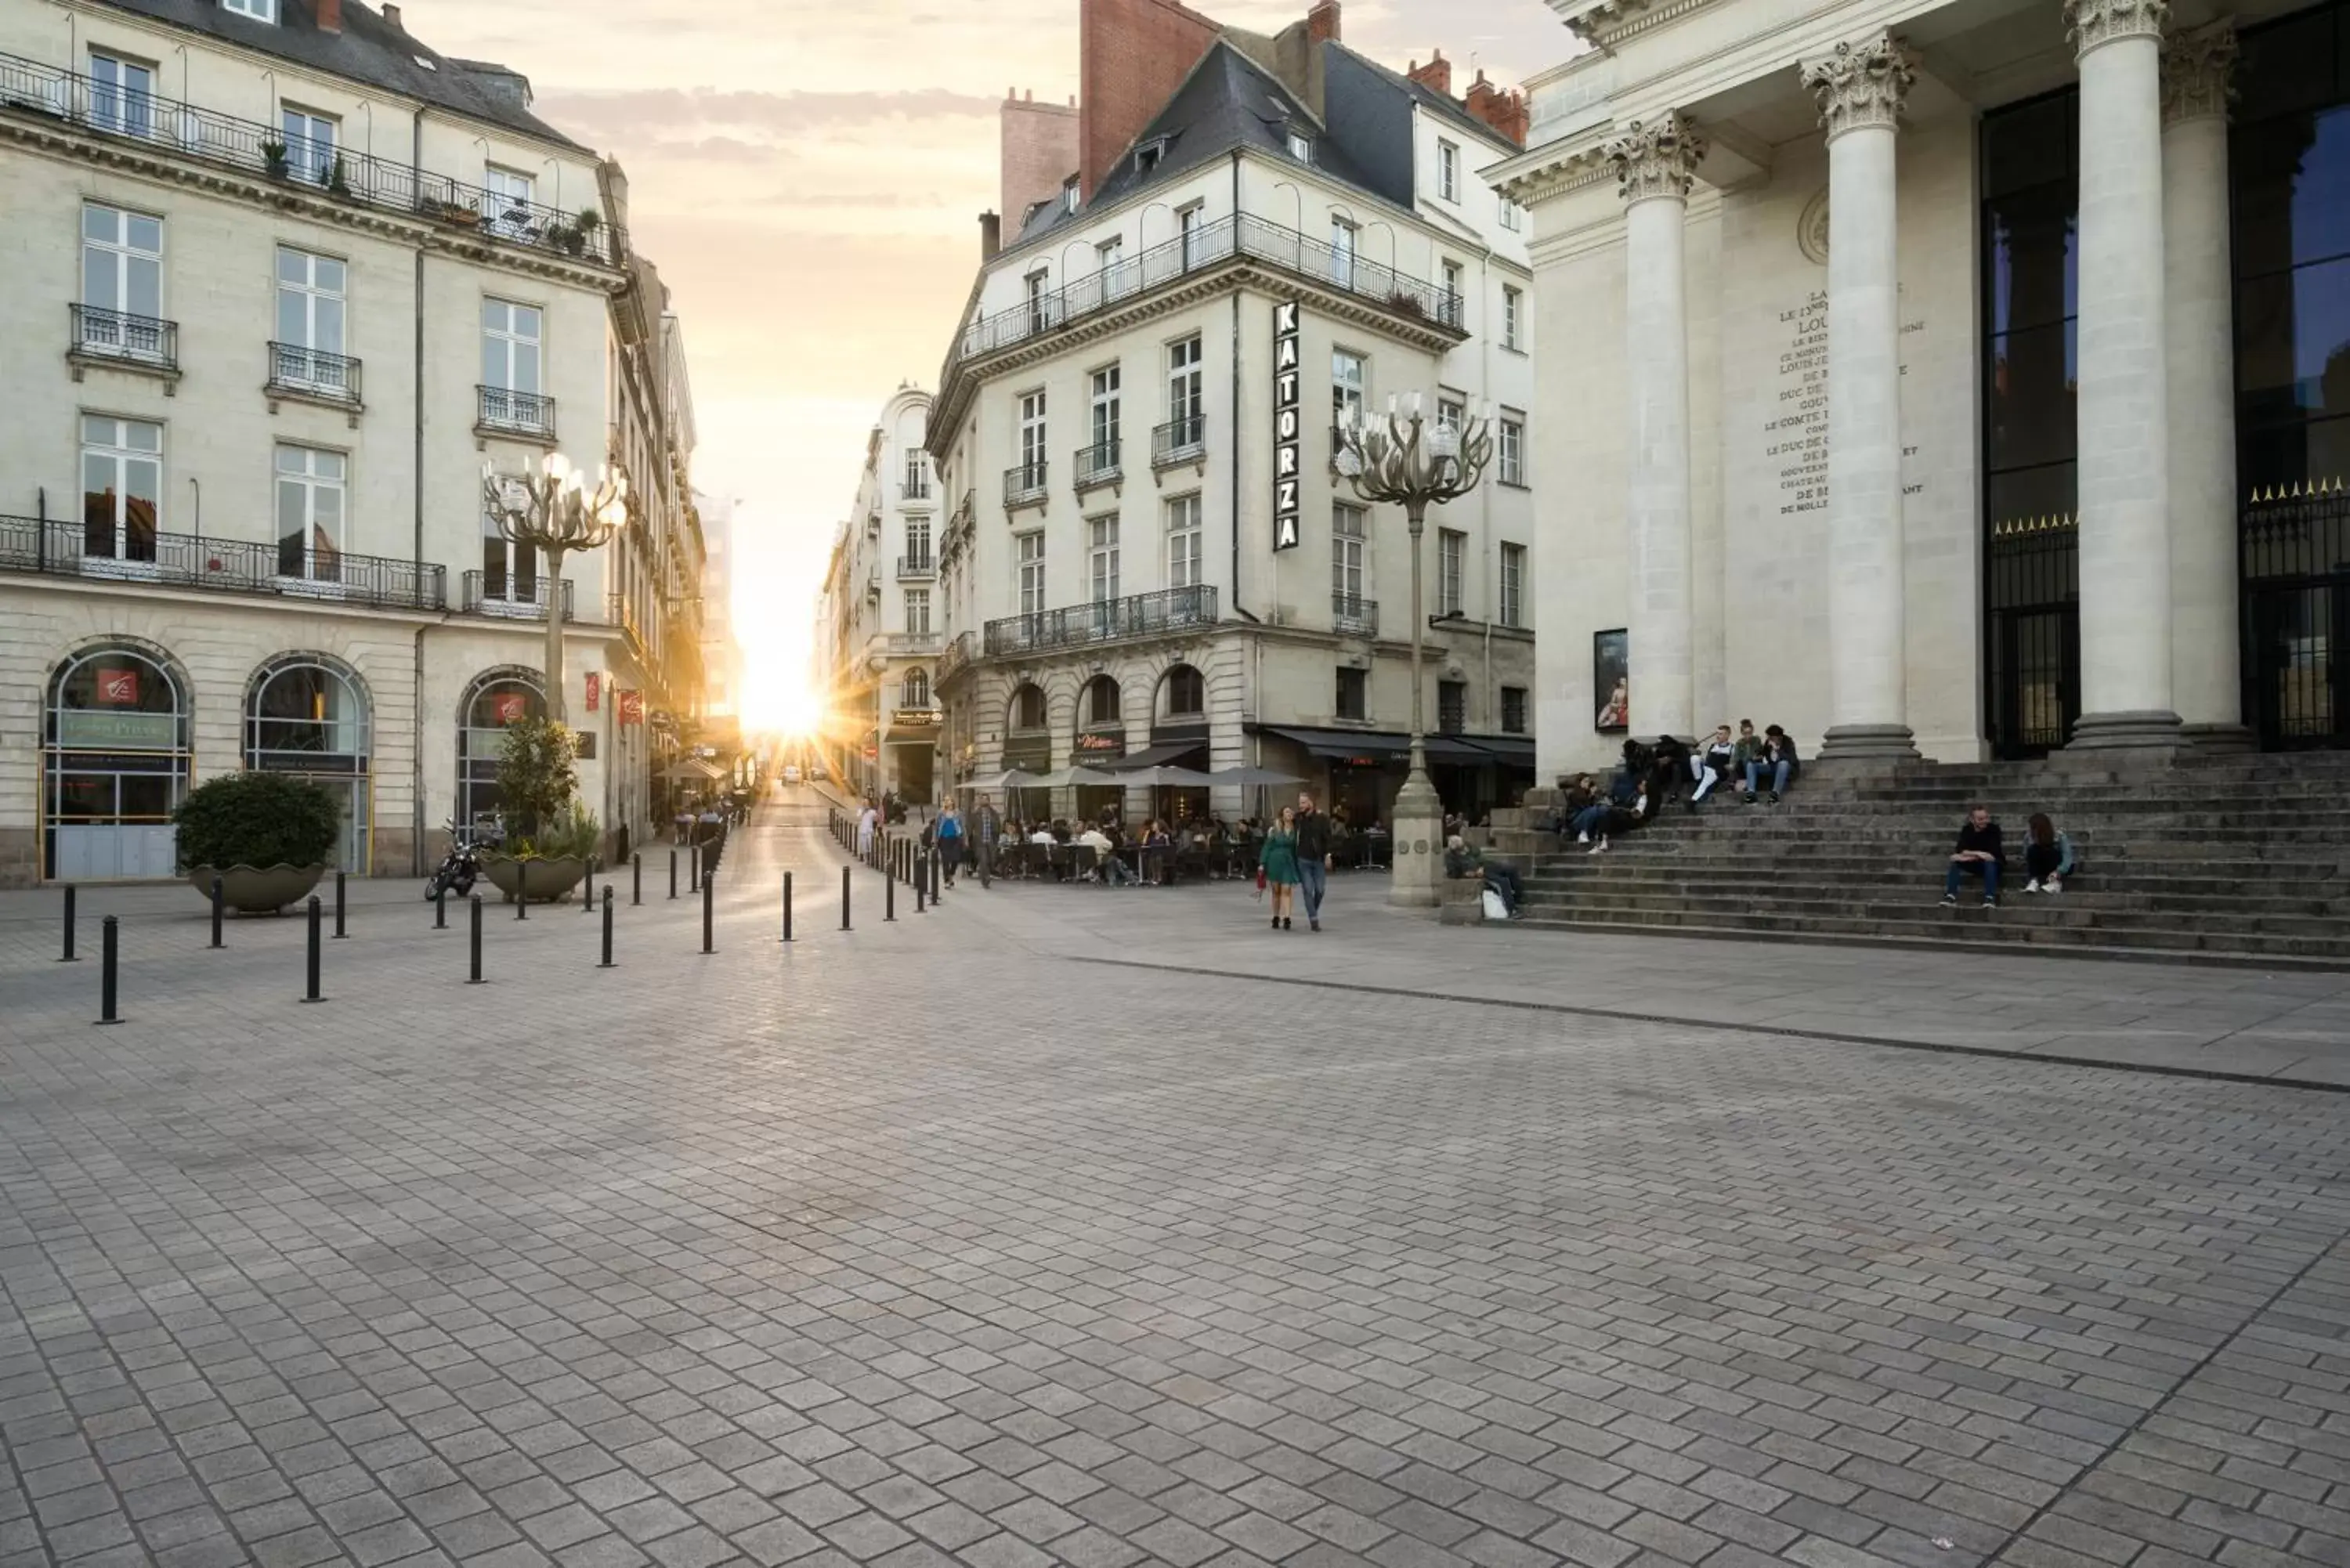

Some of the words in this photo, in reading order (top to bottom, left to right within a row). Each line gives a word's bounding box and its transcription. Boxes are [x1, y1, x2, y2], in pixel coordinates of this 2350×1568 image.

[1280, 303, 1296, 547] KATORZA
[1780, 411, 1820, 427] COMTE
[1781, 439, 1804, 453] DUC
